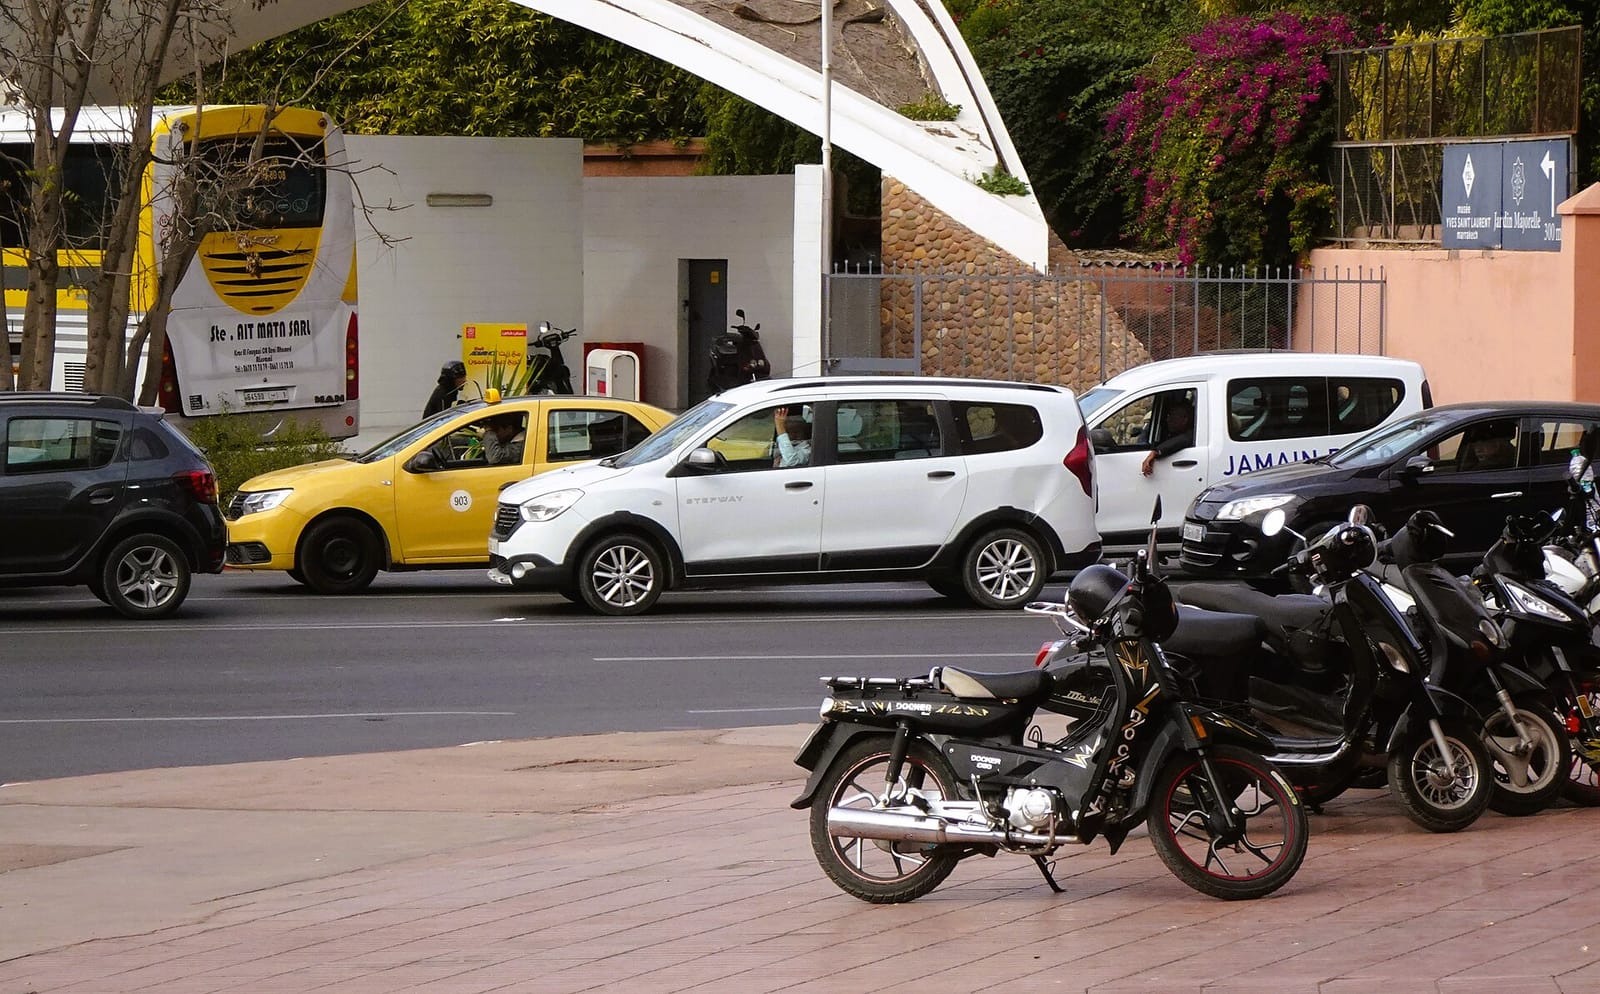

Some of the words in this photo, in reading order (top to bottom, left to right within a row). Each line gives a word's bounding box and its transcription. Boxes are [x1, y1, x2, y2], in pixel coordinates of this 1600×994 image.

[1446, 217, 1457, 228] YVES
[1457, 217, 1470, 228] SAINT
[1471, 217, 1491, 228] LAURENT
[1493, 210, 1513, 232] Jardin
[1513, 210, 1541, 234] Majorelle
[237, 323, 254, 340] AIT
[289, 319, 311, 337] SARL
[314, 394, 345, 403] MAN
[454, 495, 468, 506] 903
[686, 496, 744, 504] STEPWAY
[896, 702, 932, 712] DOCKER
[970, 754, 1001, 765] DOCKER
